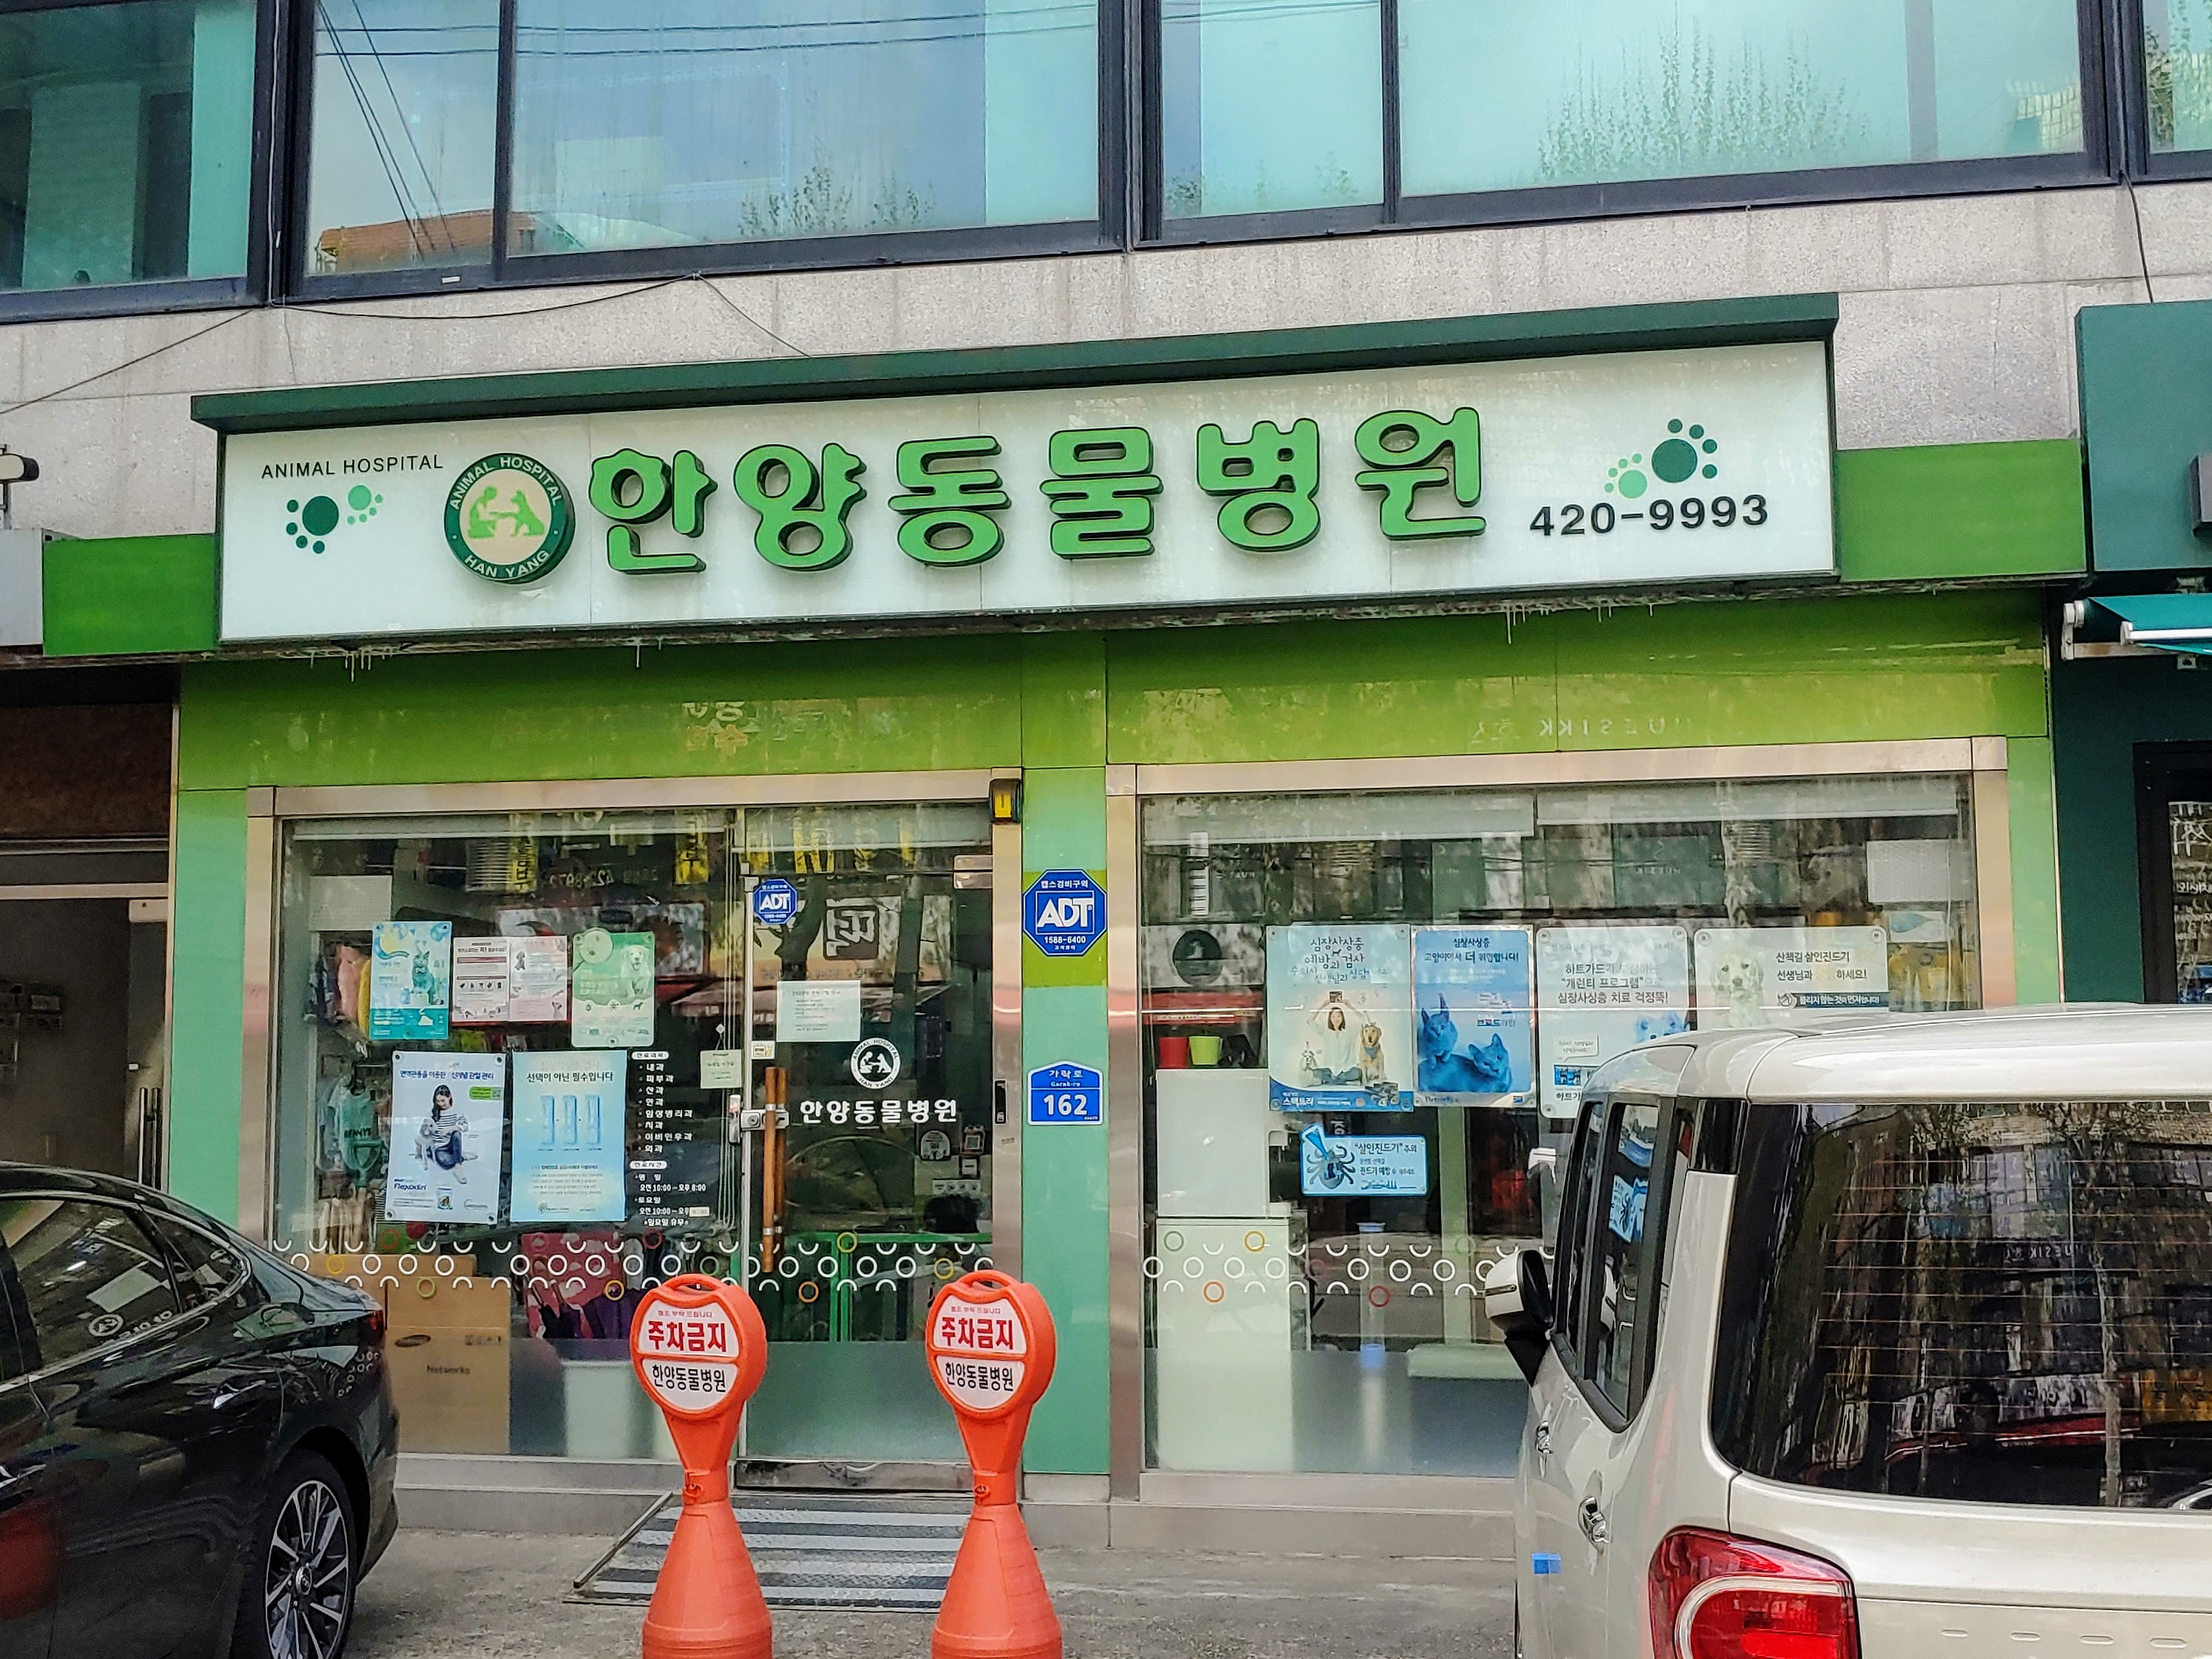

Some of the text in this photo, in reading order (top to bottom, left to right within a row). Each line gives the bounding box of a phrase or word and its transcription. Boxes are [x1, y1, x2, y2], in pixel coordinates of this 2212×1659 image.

[261, 454, 443, 479] ANIMAL HOSPITAL
[449, 456, 563, 510] ANIMAL HOSPITAL
[588, 406, 1485, 574] 한양동물병원
[1529, 493, 1770, 537] 420-9993
[464, 549, 550, 578] HAN YANG
[760, 893, 790, 911] ADT
[1037, 897, 1094, 927] ADT
[1044, 936, 1086, 944] 1588-6400
[1311, 936, 1364, 952] 심장사상충
[1341, 953, 1365, 969] 검사
[1464, 950, 1476, 964] 더
[1775, 951, 1850, 963] 산책길 살인진드기
[1776, 970, 1813, 981] 선생님과
[1558, 991, 1607, 1004] 심장사상충
[1610, 991, 1632, 1003] 치료
[646, 1063, 664, 1072] 내과
[526, 1071, 614, 1082] 선택이 아닌 필수입니다
[646, 1074, 675, 1083] 피부과
[1555, 1091, 1582, 1102] 하트가
[800, 1099, 957, 1125] 한양동물병원
[1043, 1094, 1087, 1116] 162
[1360, 1167, 1378, 1176] 진드기
[652, 1183, 672, 1192] 10:00
[652, 1207, 672, 1215] 10:00
[648, 1320, 727, 1353] 주차금지
[941, 1317, 1013, 1350] 주차금지
[652, 1364, 726, 1393] 한양동물병원
[945, 1362, 1014, 1392] 한양동물병원
